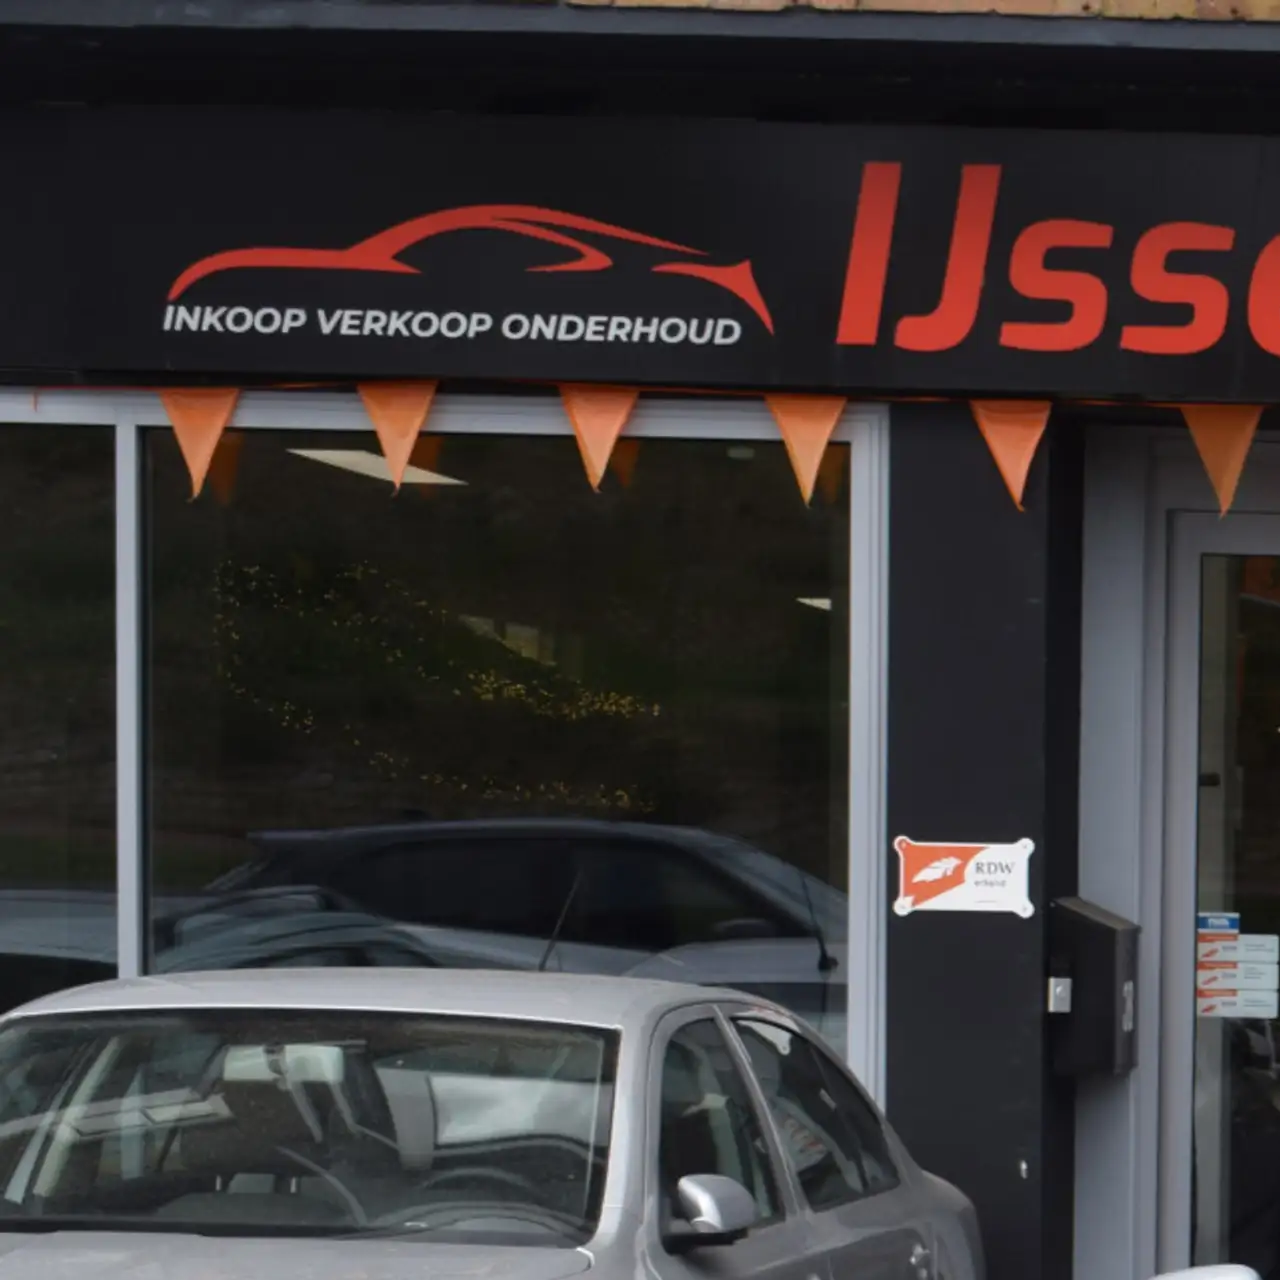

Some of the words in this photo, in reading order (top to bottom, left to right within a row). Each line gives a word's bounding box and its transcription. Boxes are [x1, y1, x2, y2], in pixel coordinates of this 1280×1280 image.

[163, 305, 307, 334] INKOOP
[317, 309, 493, 338] VERKOOP
[501, 313, 742, 346] ONDERHOUD
[975, 861, 1016, 875] RDW
